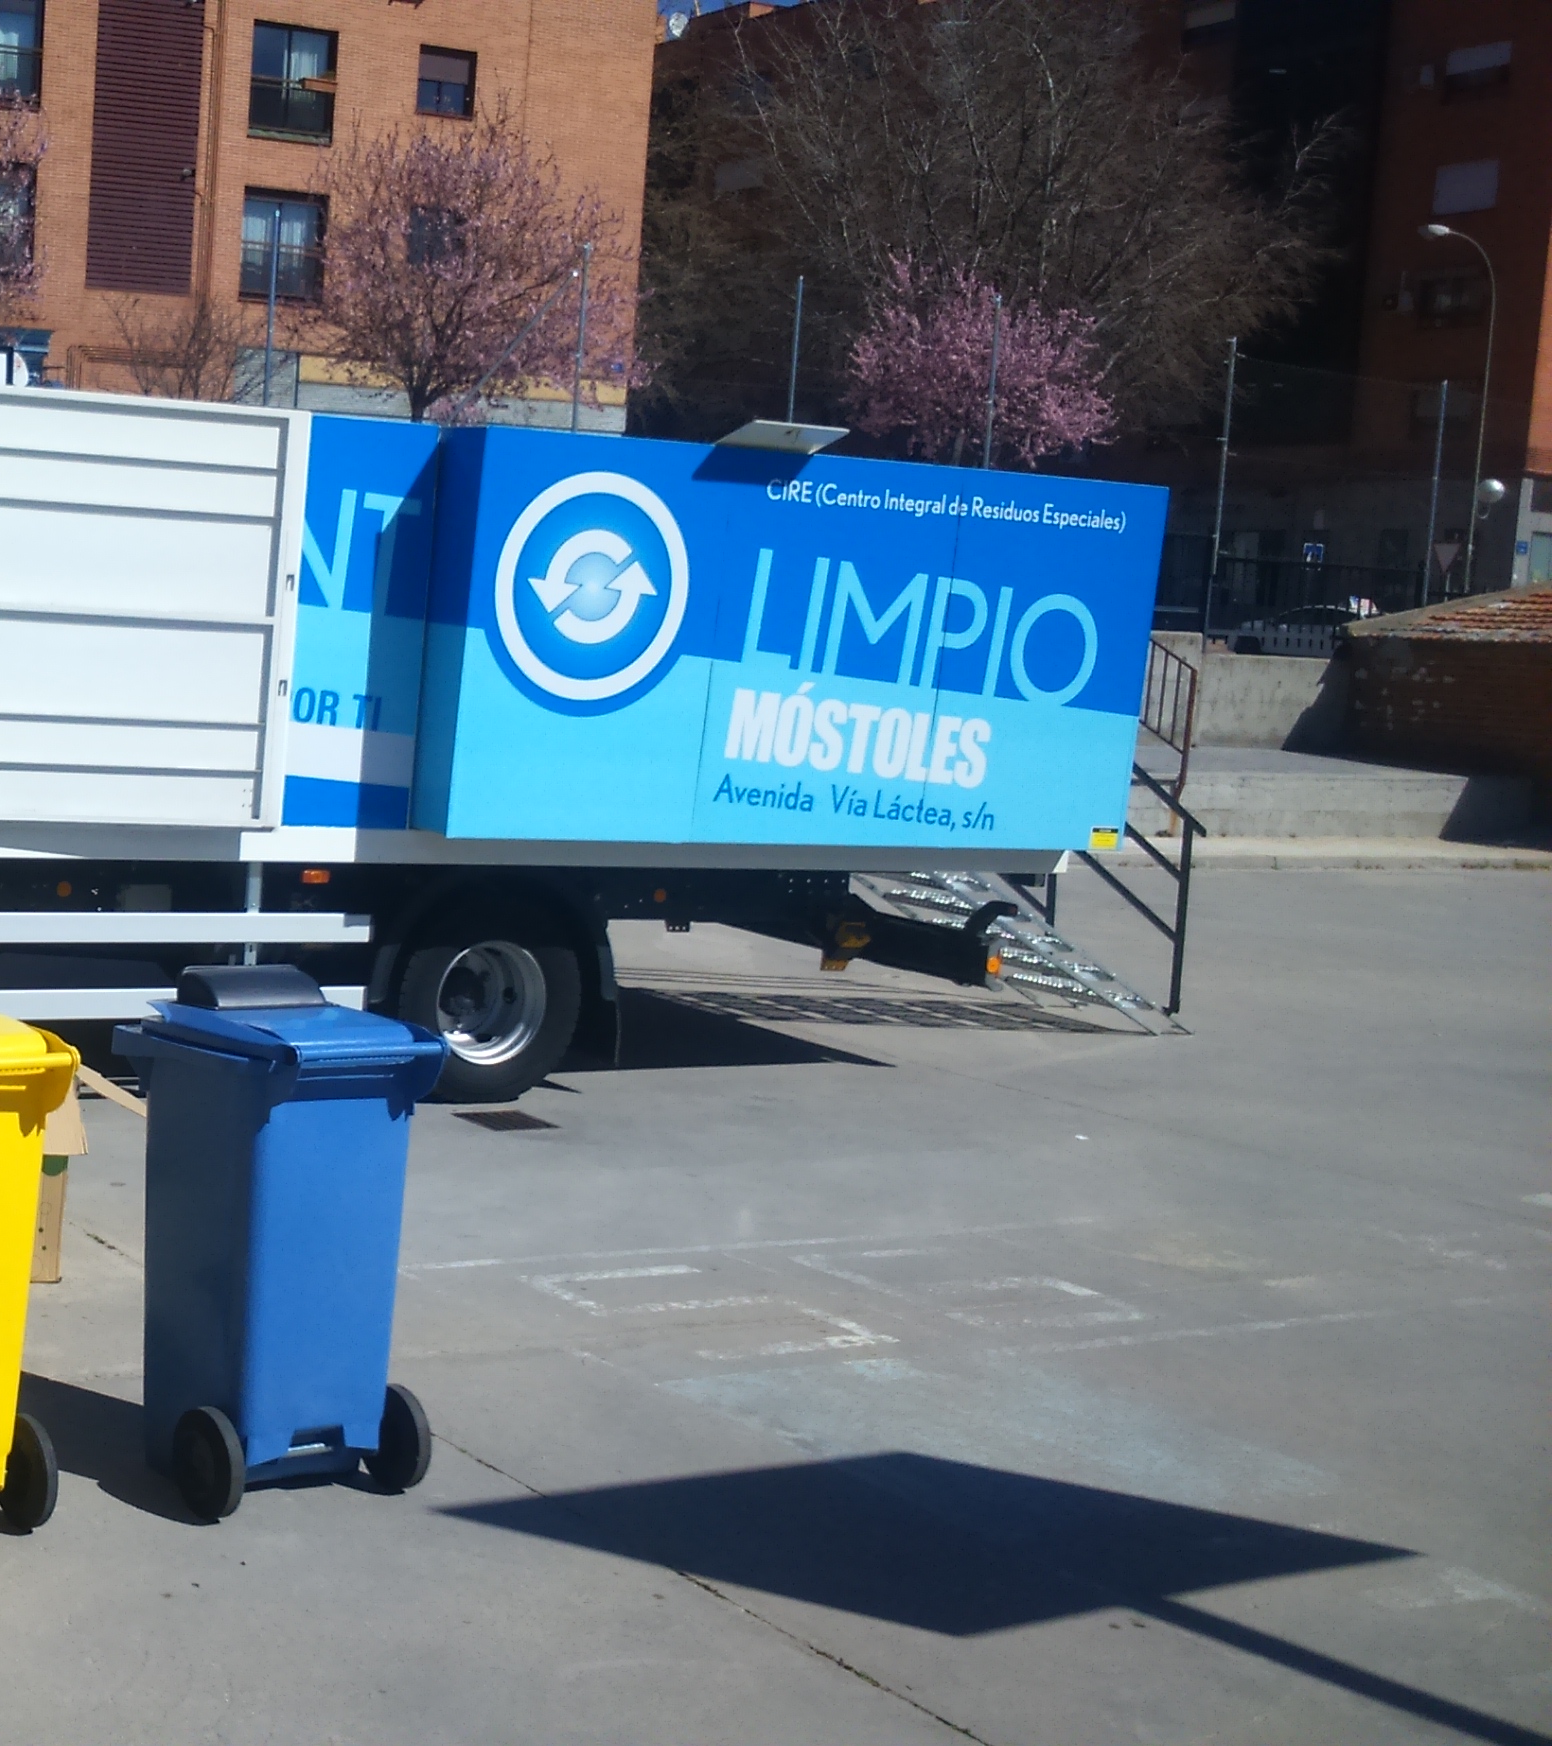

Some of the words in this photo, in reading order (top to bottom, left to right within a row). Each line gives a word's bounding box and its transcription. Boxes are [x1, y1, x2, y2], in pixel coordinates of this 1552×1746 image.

[767, 478, 813, 503] CIRE
[816, 483, 881, 508] (Centro
[884, 489, 946, 517] Integral
[948, 494, 968, 517] de
[971, 496, 1039, 523] Residuos
[1043, 503, 1126, 534] Especiales)
[741, 547, 1098, 706] LIMPIO
[292, 687, 340, 727] OR
[353, 694, 382, 732] TI
[724, 682, 992, 789] MÓSTOLES
[713, 774, 814, 812] Avenida
[831, 784, 867, 817] Vía
[873, 789, 956, 832] Láctea,
[962, 801, 995, 832] s/n
